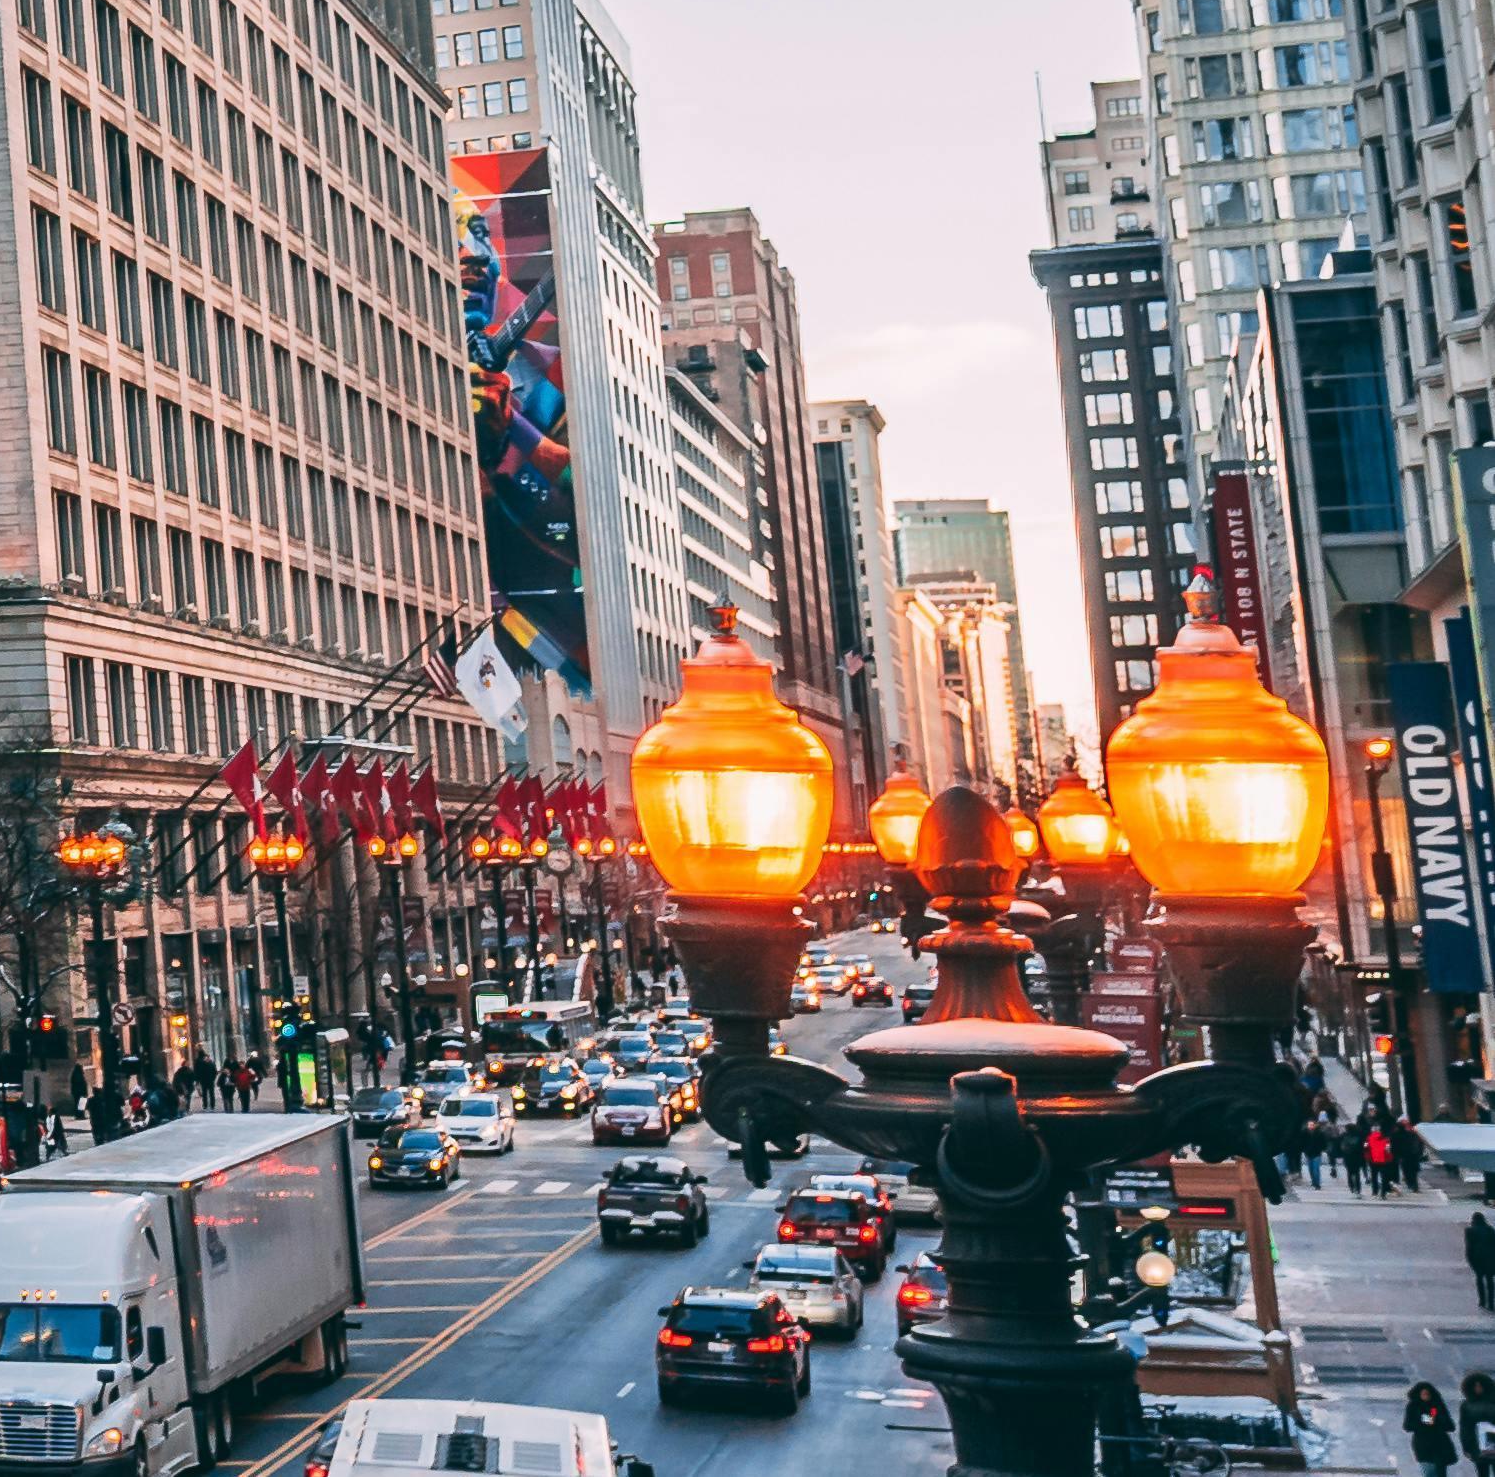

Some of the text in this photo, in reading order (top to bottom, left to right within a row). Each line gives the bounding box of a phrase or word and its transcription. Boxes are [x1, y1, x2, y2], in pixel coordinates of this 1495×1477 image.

[1226, 507, 1248, 560] STATE
[1234, 567, 1250, 579] N
[1236, 585, 1255, 618] 108
[1400, 724, 1470, 927] OLD NAVY
